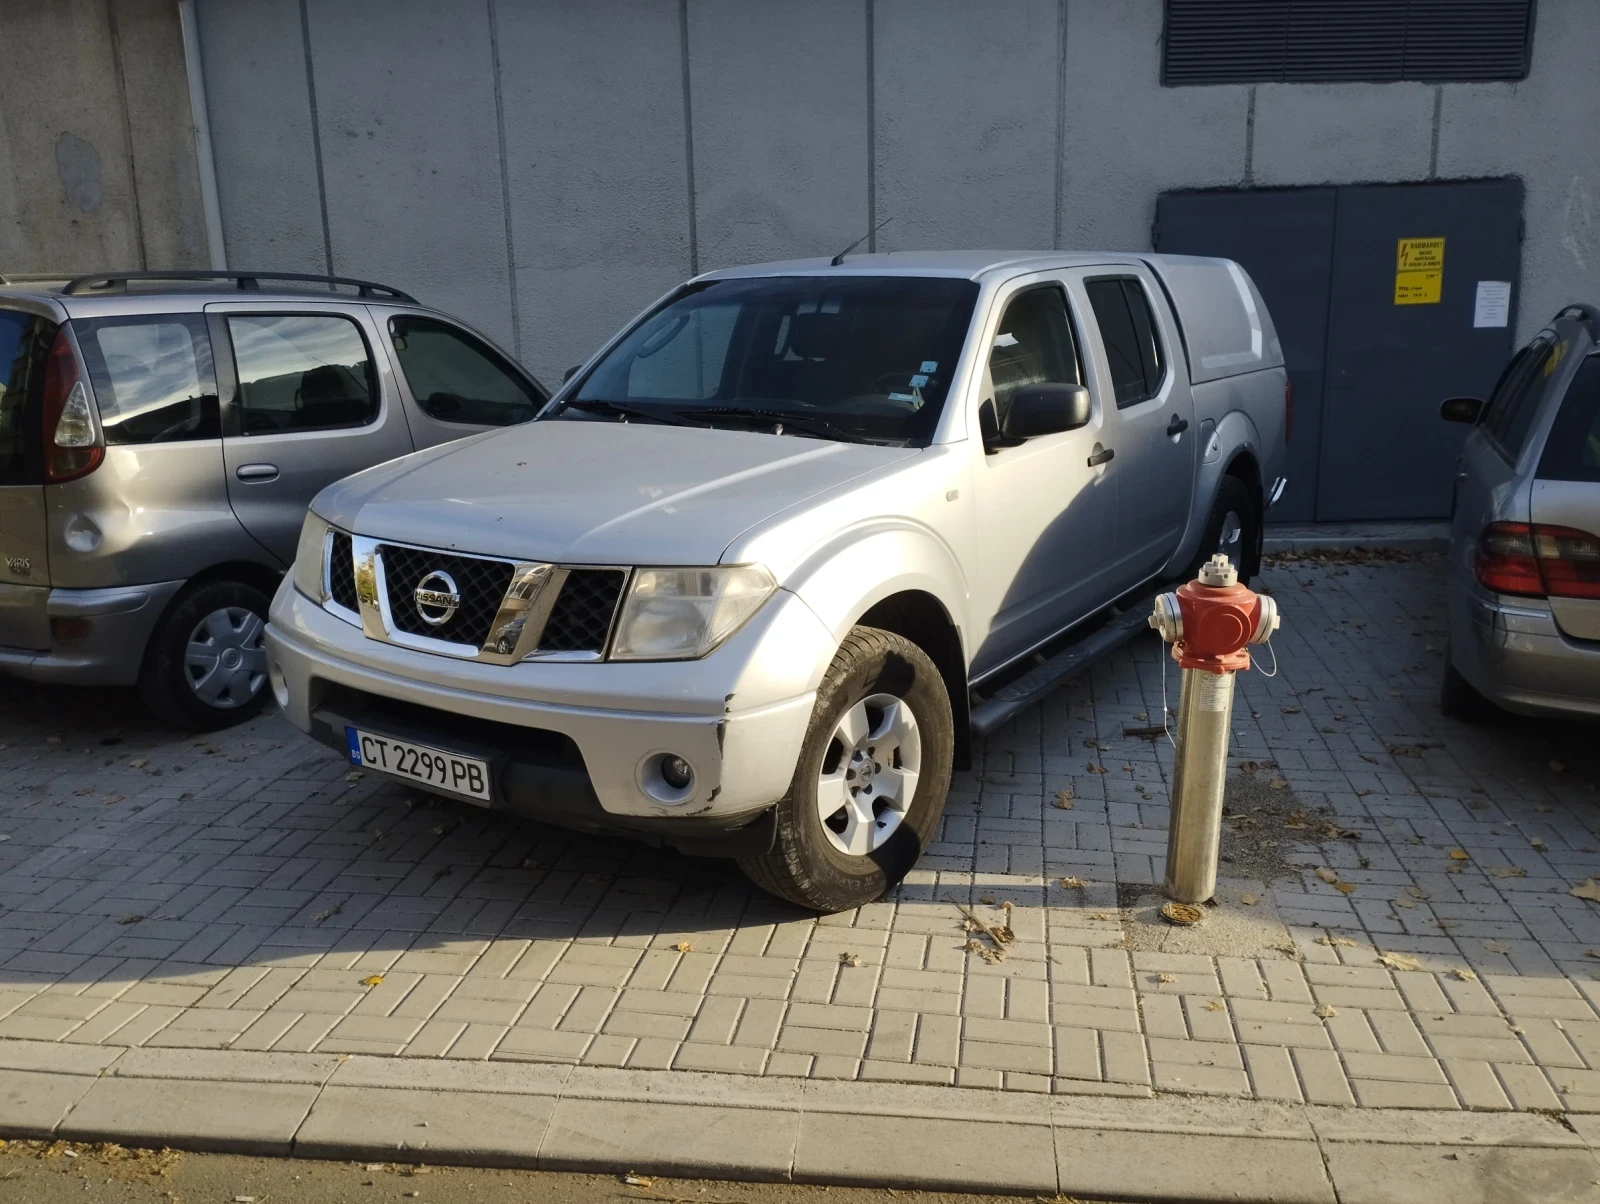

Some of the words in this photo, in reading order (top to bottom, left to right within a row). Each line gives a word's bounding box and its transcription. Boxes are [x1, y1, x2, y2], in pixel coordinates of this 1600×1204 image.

[5, 556, 30, 568] YARIS
[415, 591, 452, 606] NISSAN
[351, 749, 361, 760] BG
[361, 736, 389, 768] CT
[393, 744, 447, 784] 2299
[450, 759, 485, 794] PB
